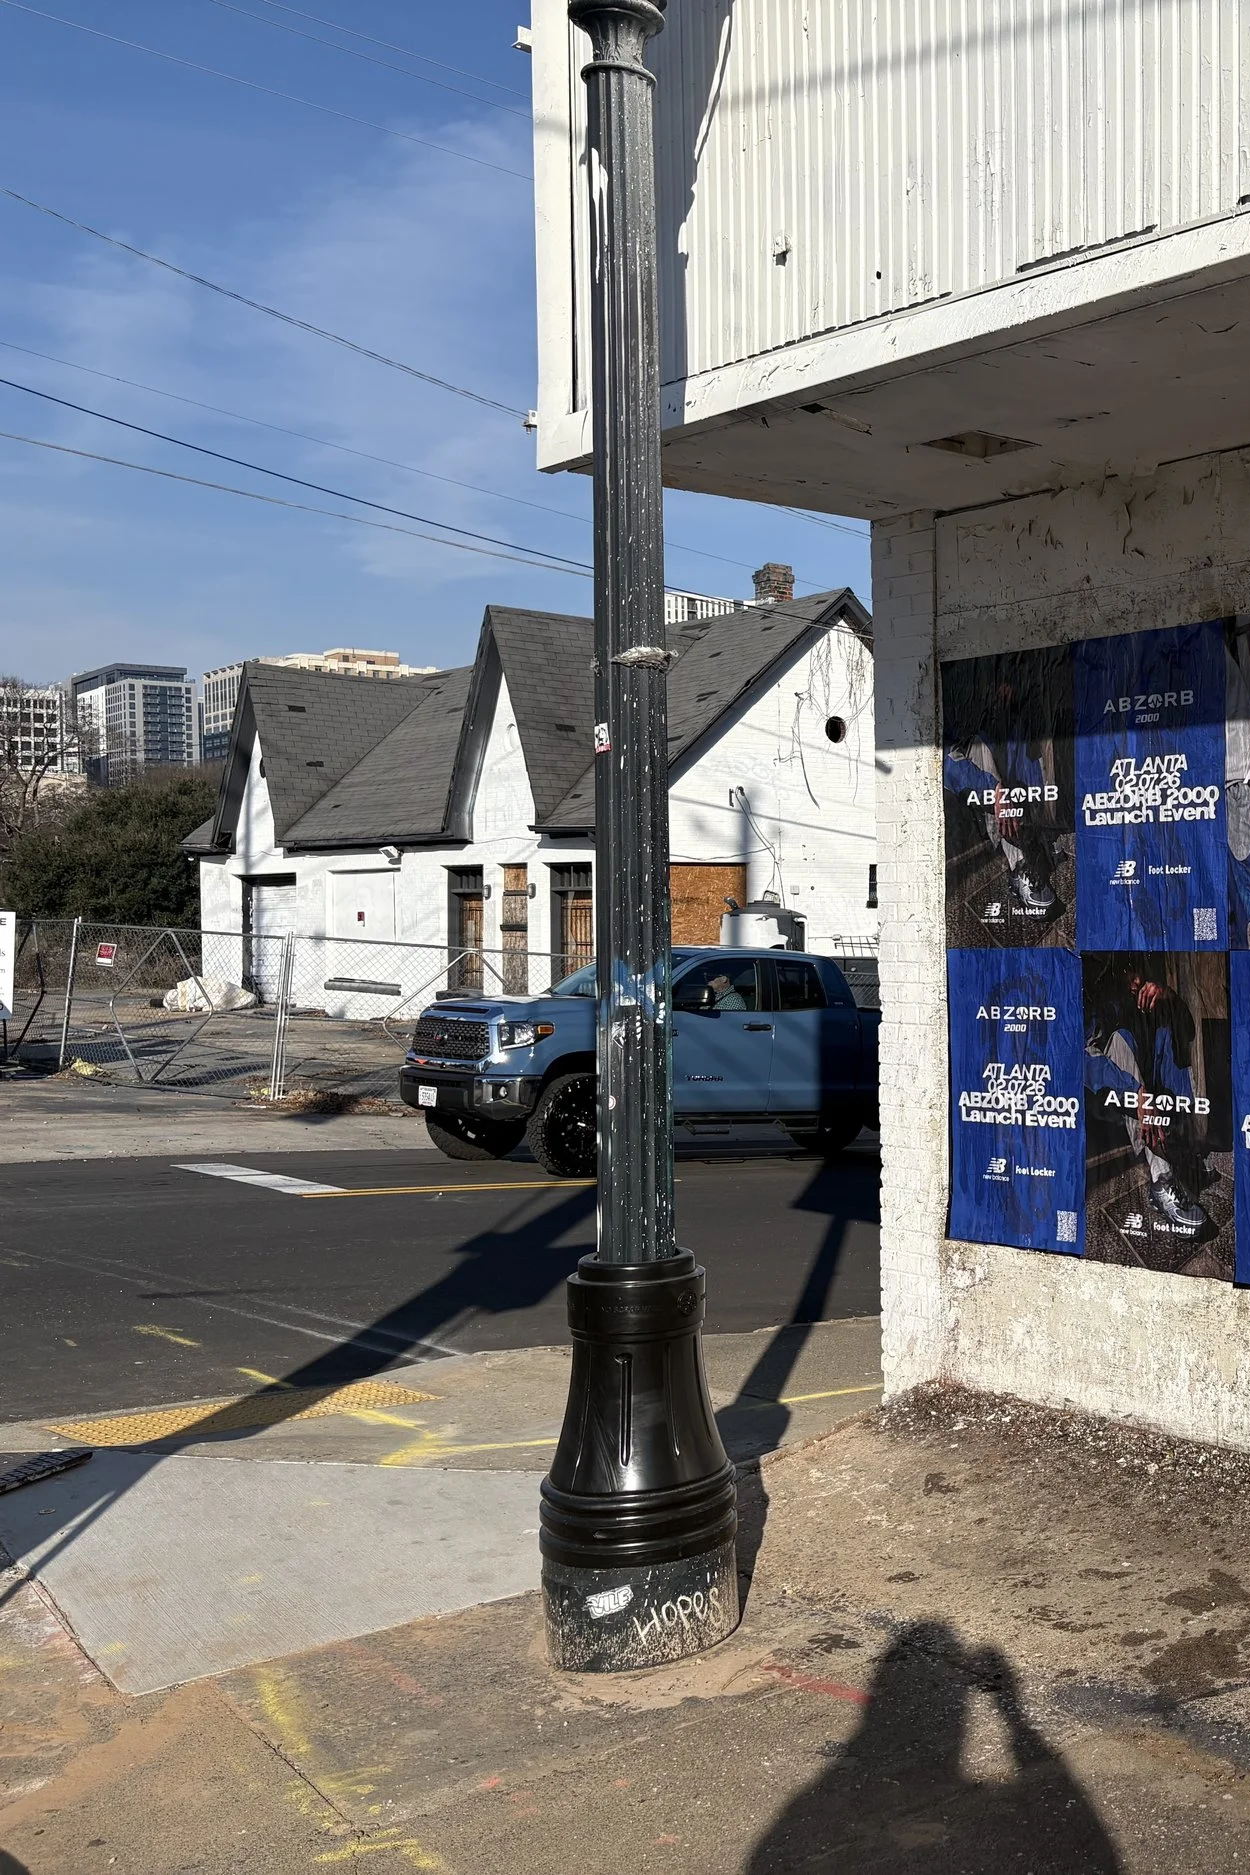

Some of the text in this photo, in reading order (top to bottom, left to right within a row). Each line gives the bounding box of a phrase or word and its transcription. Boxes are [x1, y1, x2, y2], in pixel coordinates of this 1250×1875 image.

[1103, 689, 1194, 714] ABZORB
[1135, 713, 1160, 723] 2000
[1110, 754, 1188, 777] ATLANTA
[966, 784, 1059, 806] ABZORB
[1082, 785, 1220, 810] ABZORB 2000
[998, 808, 1024, 818] 2000
[1085, 804, 1216, 826] Launch Event
[1148, 864, 1192, 875] Foot Locker
[976, 1006, 1057, 1021] ABZORB
[1004, 1024, 1027, 1032] 2000
[982, 1063, 1051, 1081] ATLANTA
[958, 1091, 1080, 1114] ABZORB 2000
[1103, 1090, 1211, 1115] ABZORB
[961, 1106, 1077, 1129] Launch Event
[1142, 1114, 1171, 1127] 2000
[1030, 1166, 1056, 1177] Locker
[1153, 1222, 1169, 1231] Foot
